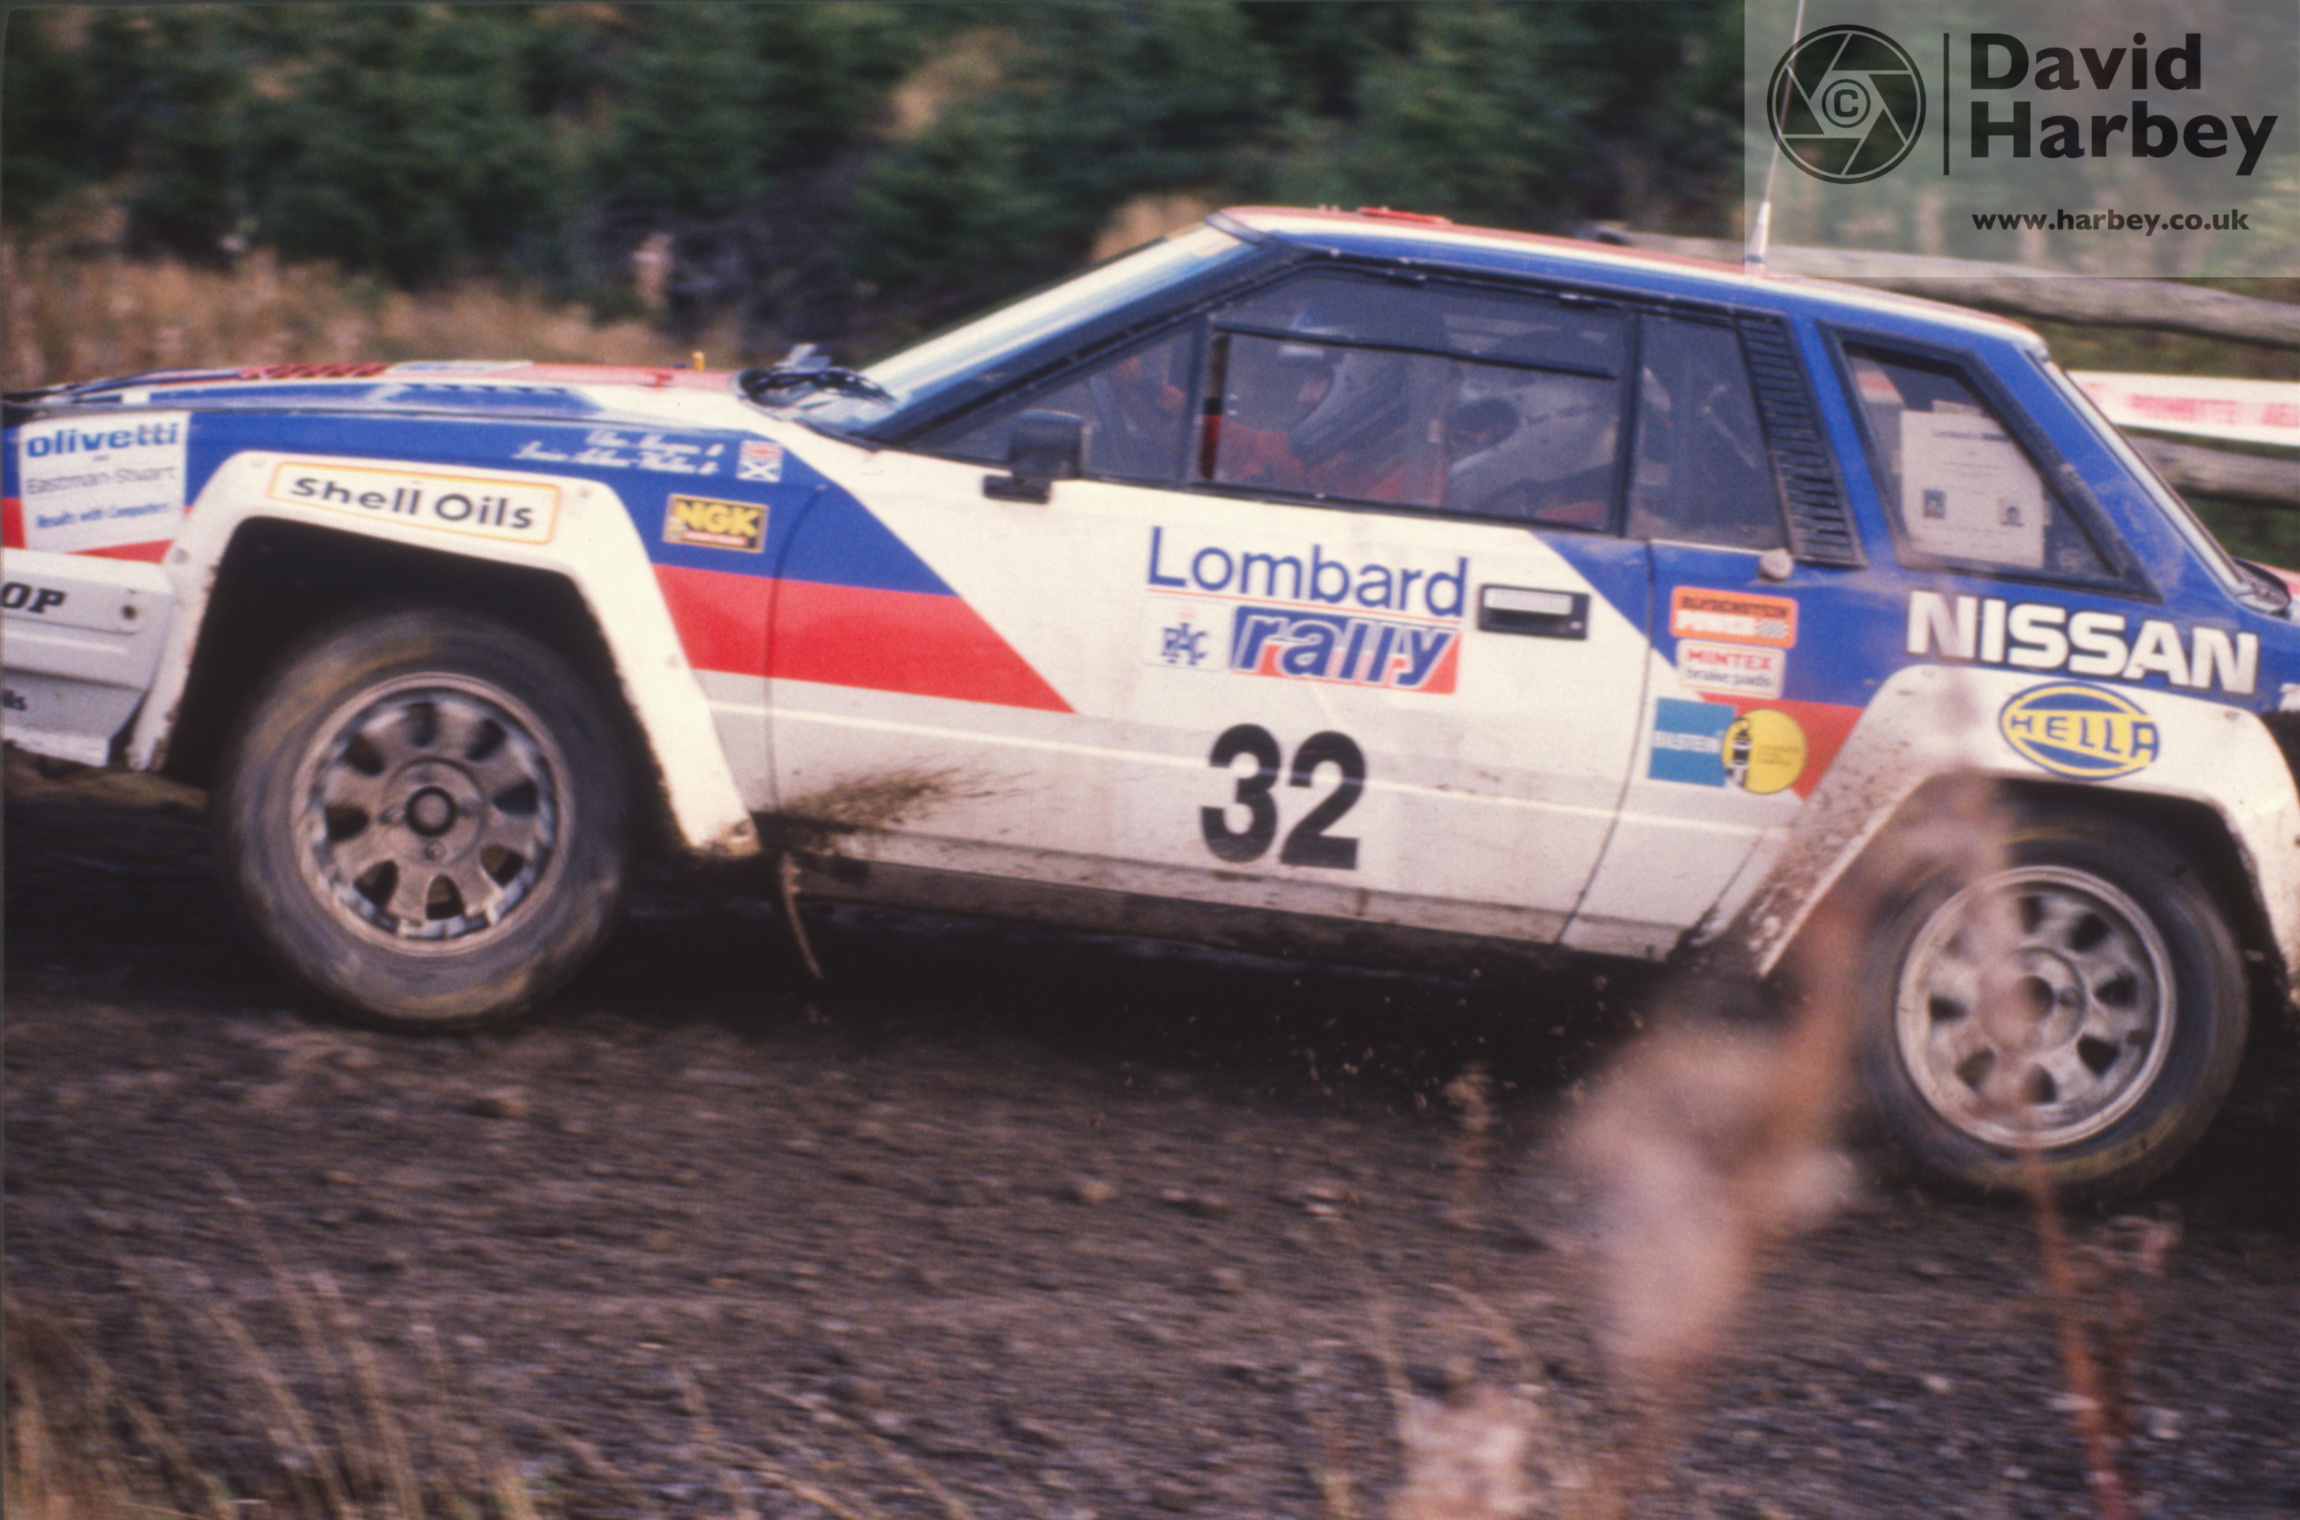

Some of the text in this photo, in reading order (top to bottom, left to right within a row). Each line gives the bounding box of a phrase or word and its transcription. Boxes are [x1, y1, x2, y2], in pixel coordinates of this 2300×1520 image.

[26, 423, 178, 458] olivetti
[291, 477, 533, 529] Shell Oils
[672, 500, 760, 538] NGK
[1146, 526, 1469, 618] Lombard
[1236, 612, 1455, 689] rally
[1907, 589, 2260, 695] NISSAN
[2009, 713, 2160, 761] HELLA
[1201, 722, 1367, 870] 32
